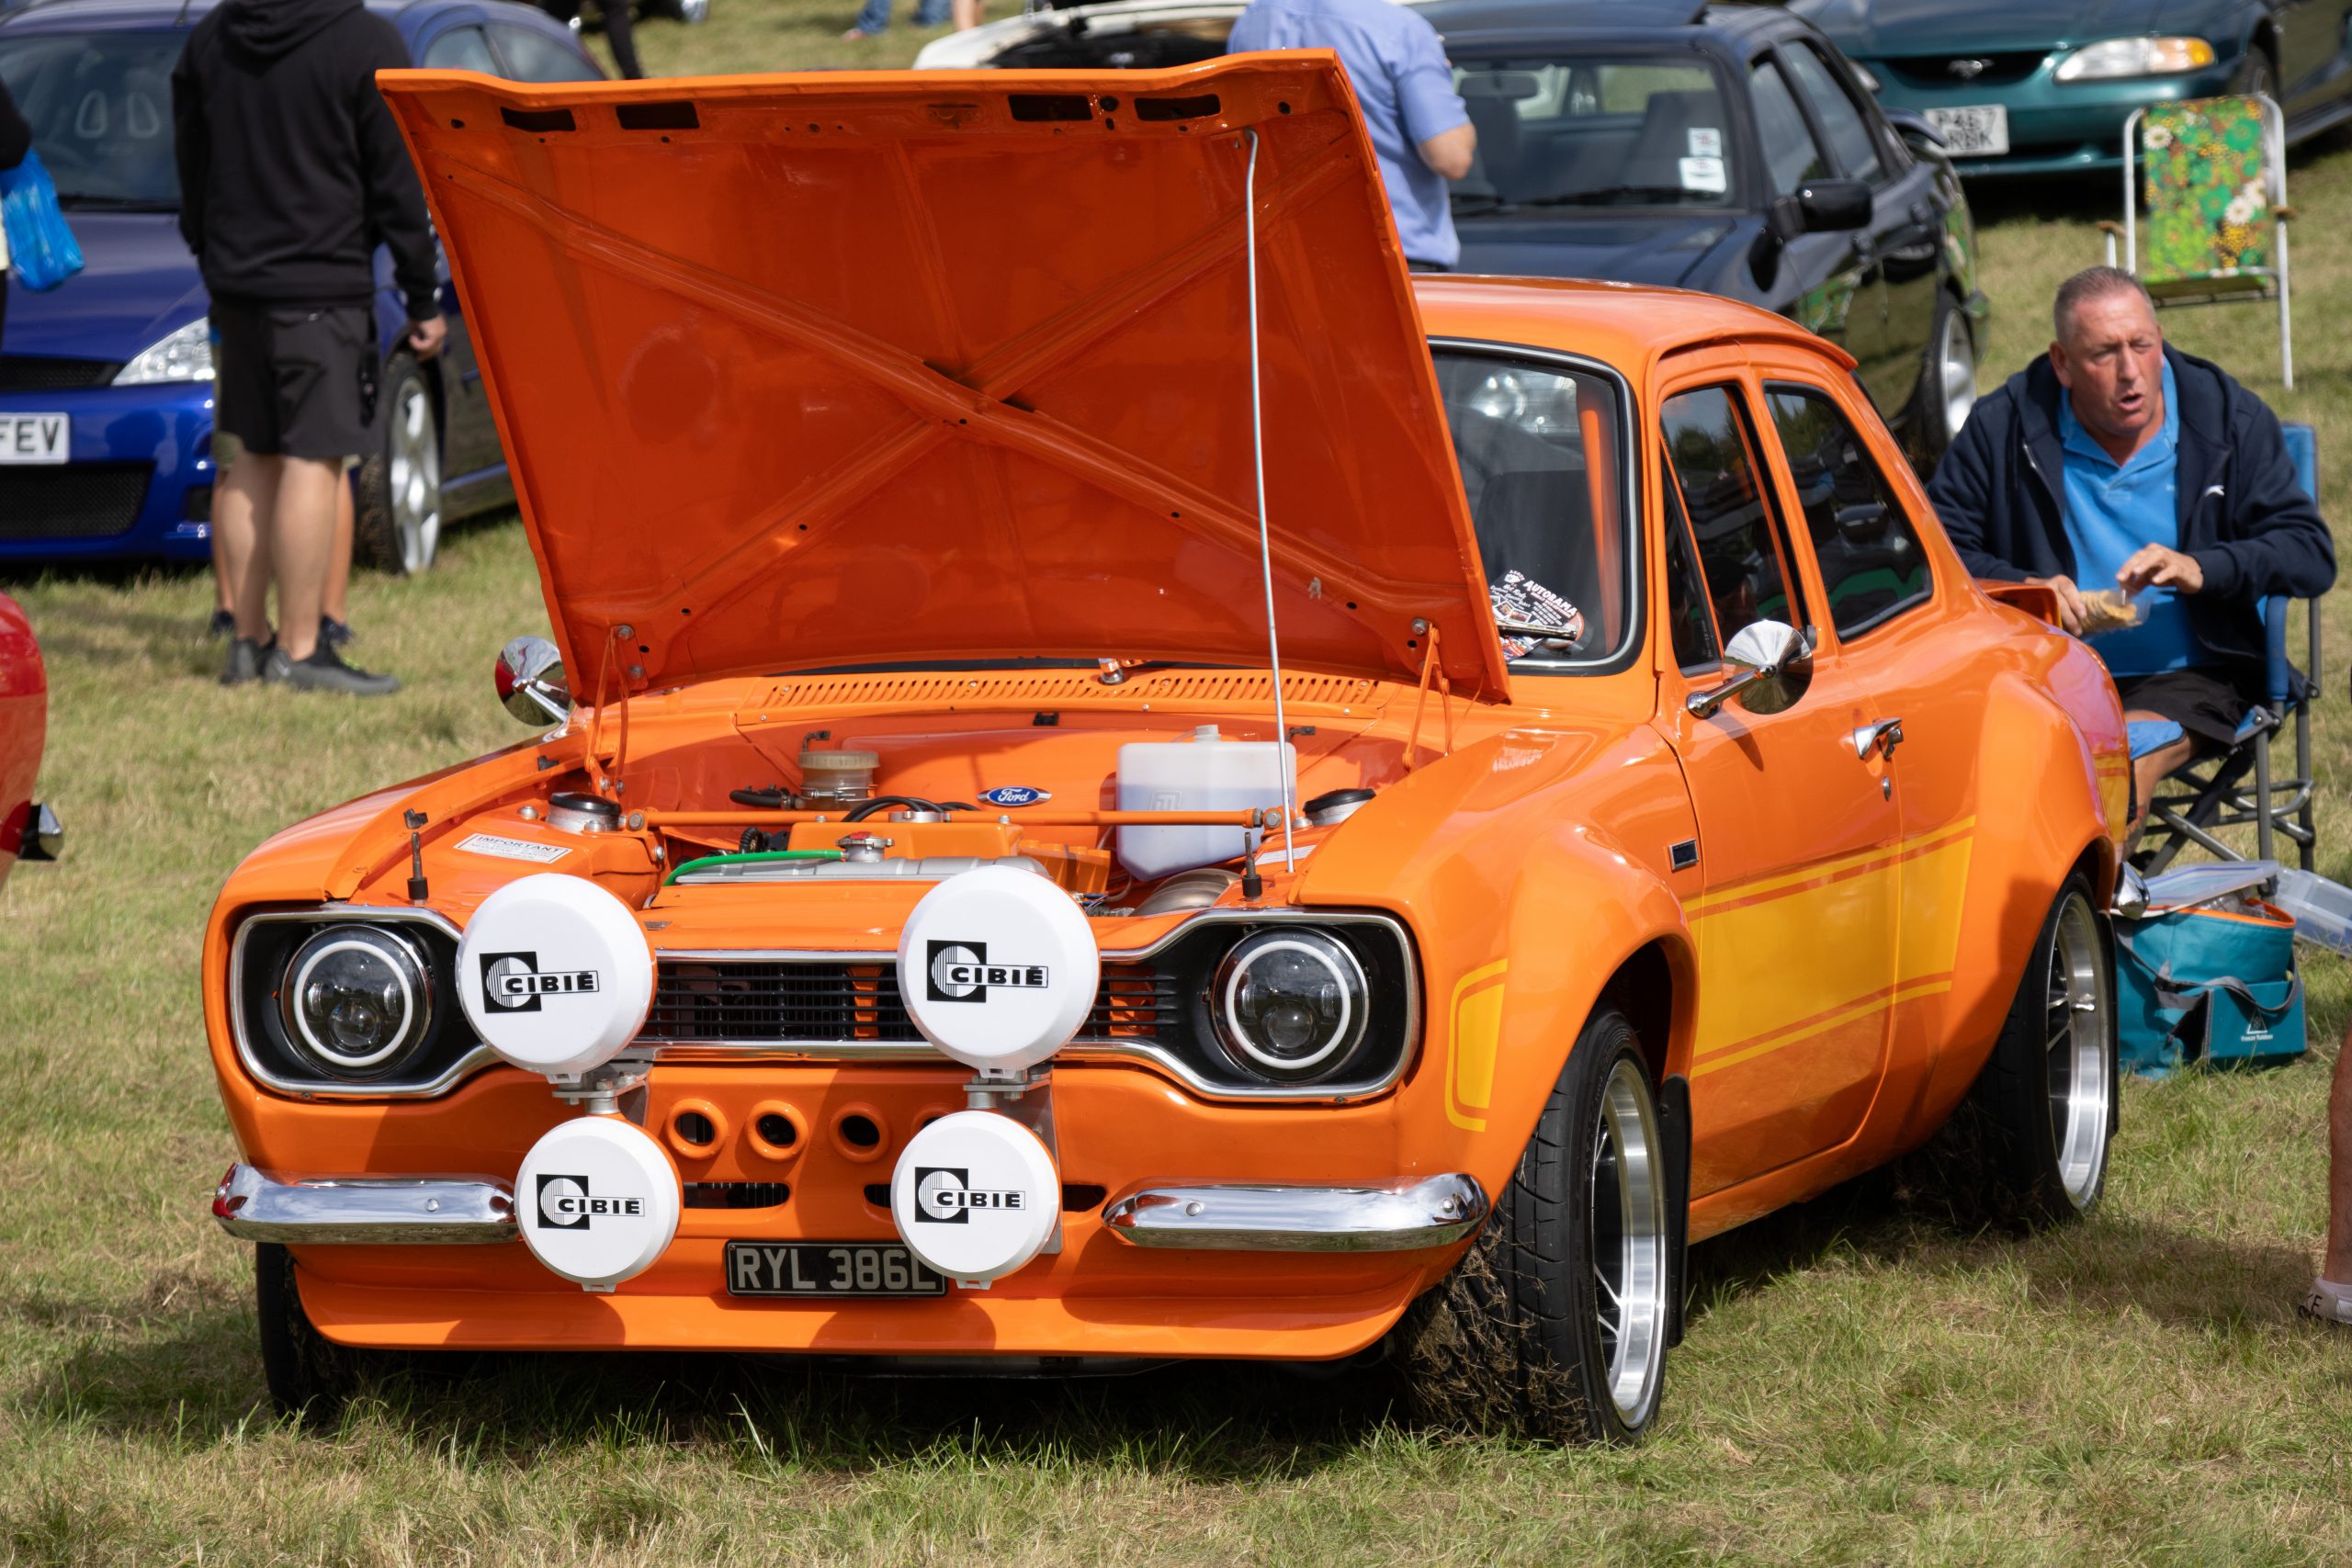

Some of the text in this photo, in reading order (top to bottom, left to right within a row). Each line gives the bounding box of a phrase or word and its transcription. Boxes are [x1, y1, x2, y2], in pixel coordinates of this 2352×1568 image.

[1522, 580, 1577, 616] AUTORAMA
[998, 788, 1031, 802] Ford
[479, 836, 560, 852] IMPORTANT
[736, 1248, 936, 1290] RYL 386L
